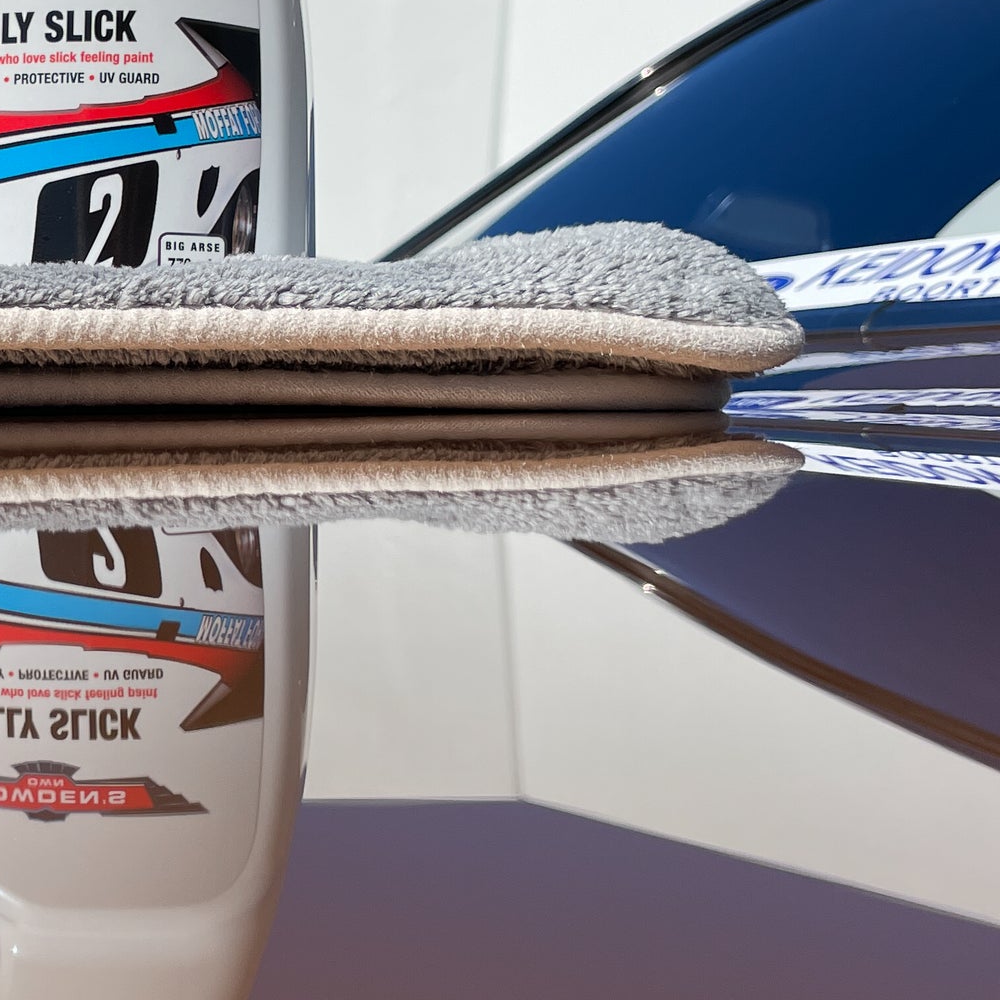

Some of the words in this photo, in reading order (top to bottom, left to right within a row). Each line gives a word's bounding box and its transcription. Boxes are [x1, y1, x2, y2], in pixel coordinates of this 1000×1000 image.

[44, 9, 137, 43] SLICK
[22, 52, 47, 64] love
[49, 51, 77, 63] slick
[80, 51, 120, 65] feeling
[123, 52, 154, 66] paint
[13, 72, 85, 85] PROTECTIVE
[99, 72, 116, 84] UV
[118, 72, 160, 84] GUARD
[192, 104, 244, 140] MOFFAT
[84, 173, 123, 265] 2
[166, 241, 185, 251] BIG
[190, 242, 220, 252] ARSE
